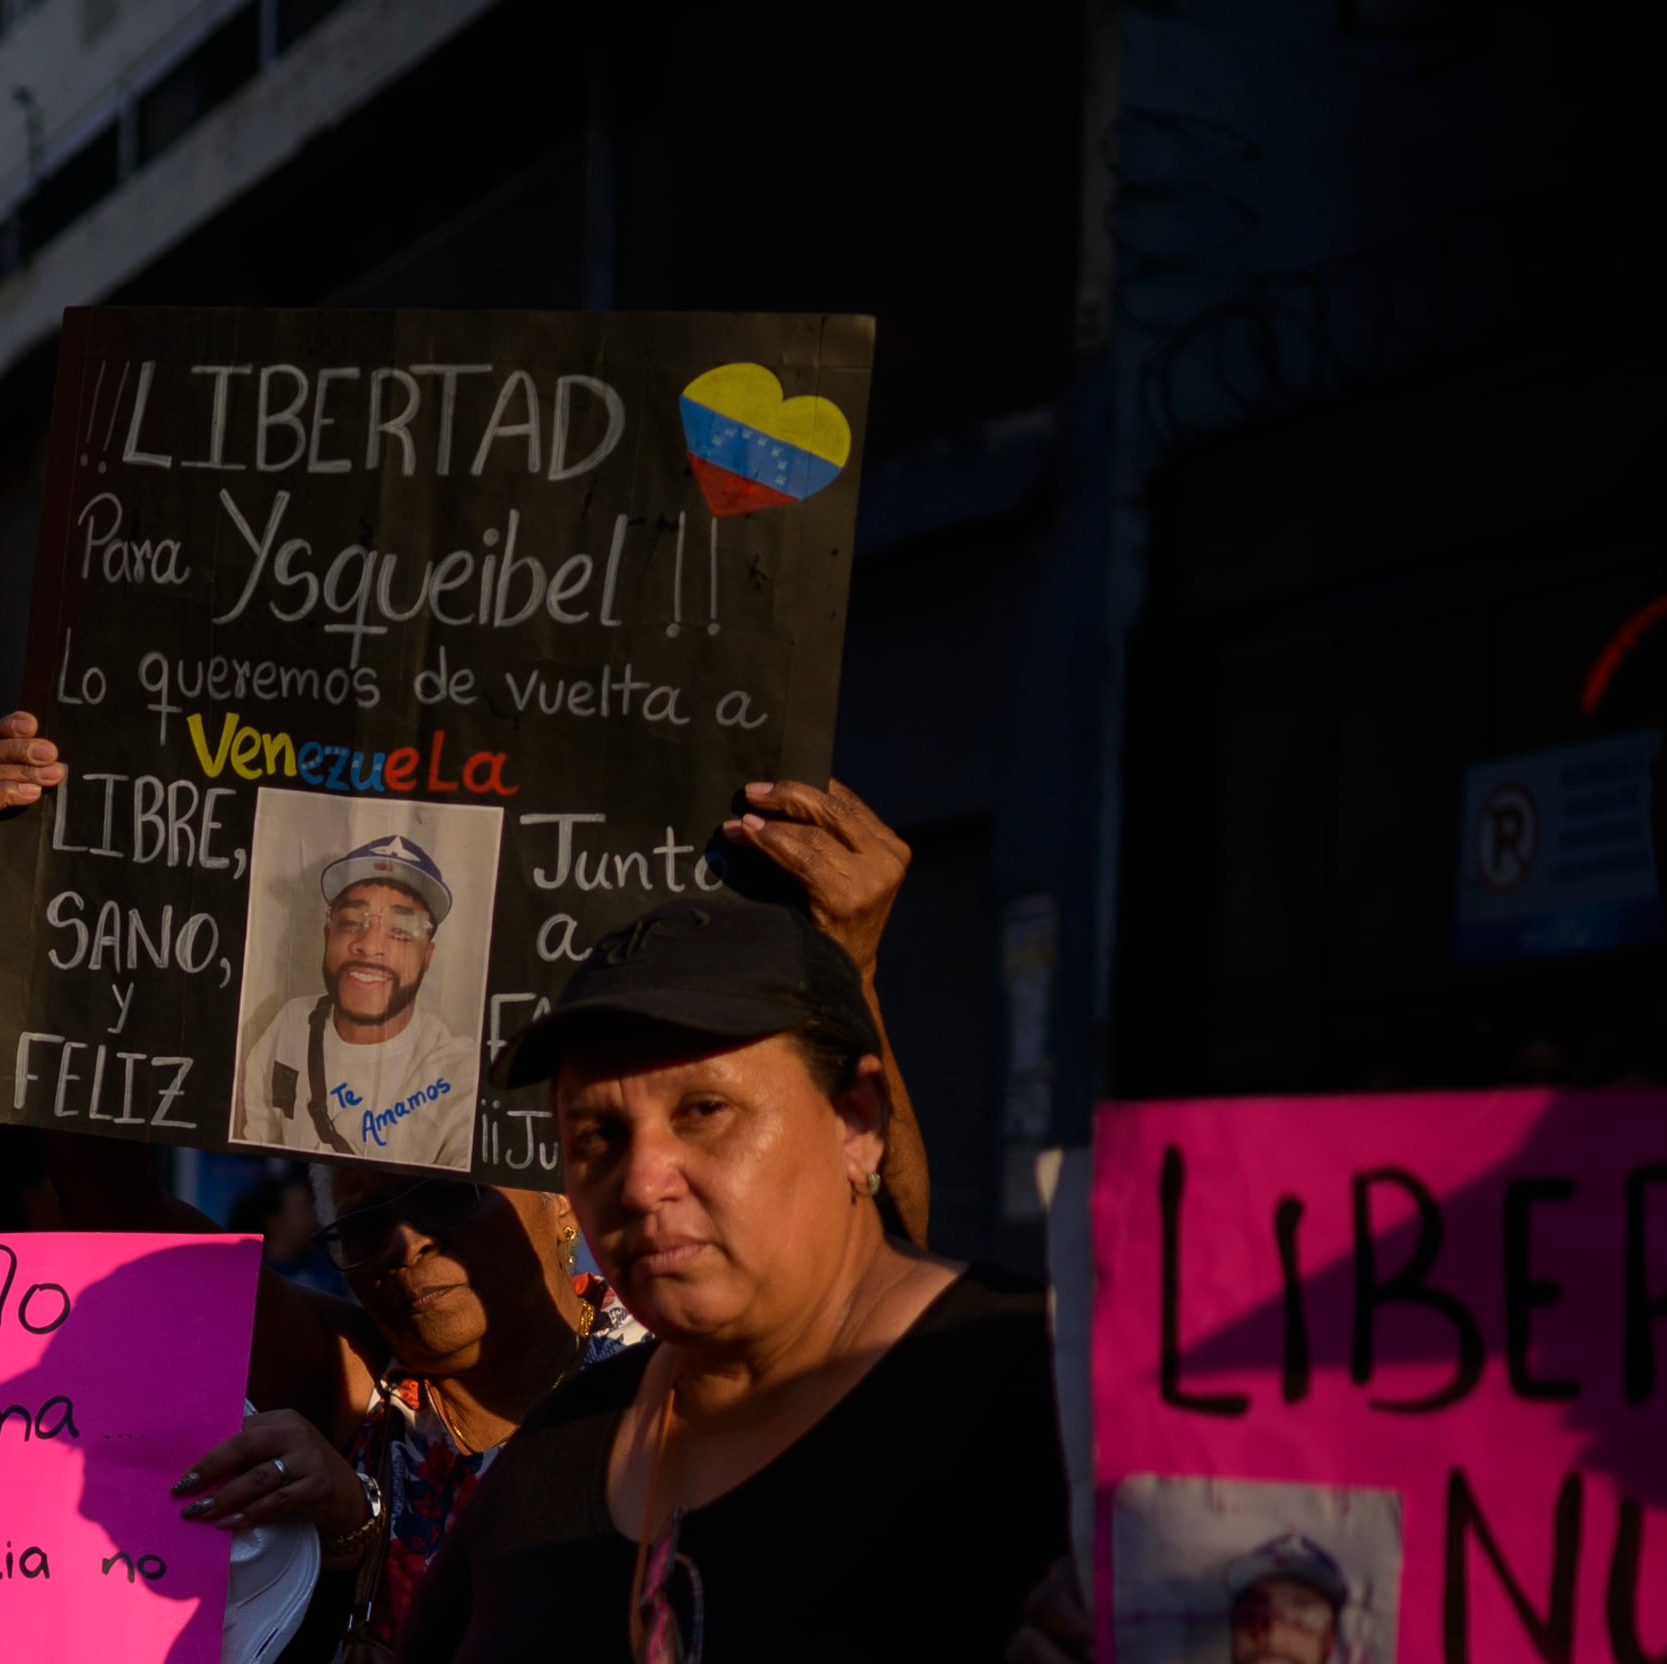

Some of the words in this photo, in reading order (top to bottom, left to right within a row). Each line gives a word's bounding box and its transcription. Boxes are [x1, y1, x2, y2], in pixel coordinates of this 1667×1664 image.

[77, 491, 190, 585] Para
[212, 489, 627, 669] Ysqueibel
[56, 627, 108, 707] Lo
[138, 651, 381, 747] queremos
[414, 645, 477, 708] de
[507, 661, 690, 727] vuelta
[715, 690, 769, 730] a
[51, 772, 249, 882] LIBRE,
[519, 812, 729, 894] Junto
[46, 889, 231, 990] SANO,
[536, 911, 595, 962] a
[13, 1030, 197, 1129] FELIZ
[330, 1082, 364, 1120] Te
[360, 1076, 452, 1148] Amamos
[100, 1544, 167, 1583] no
